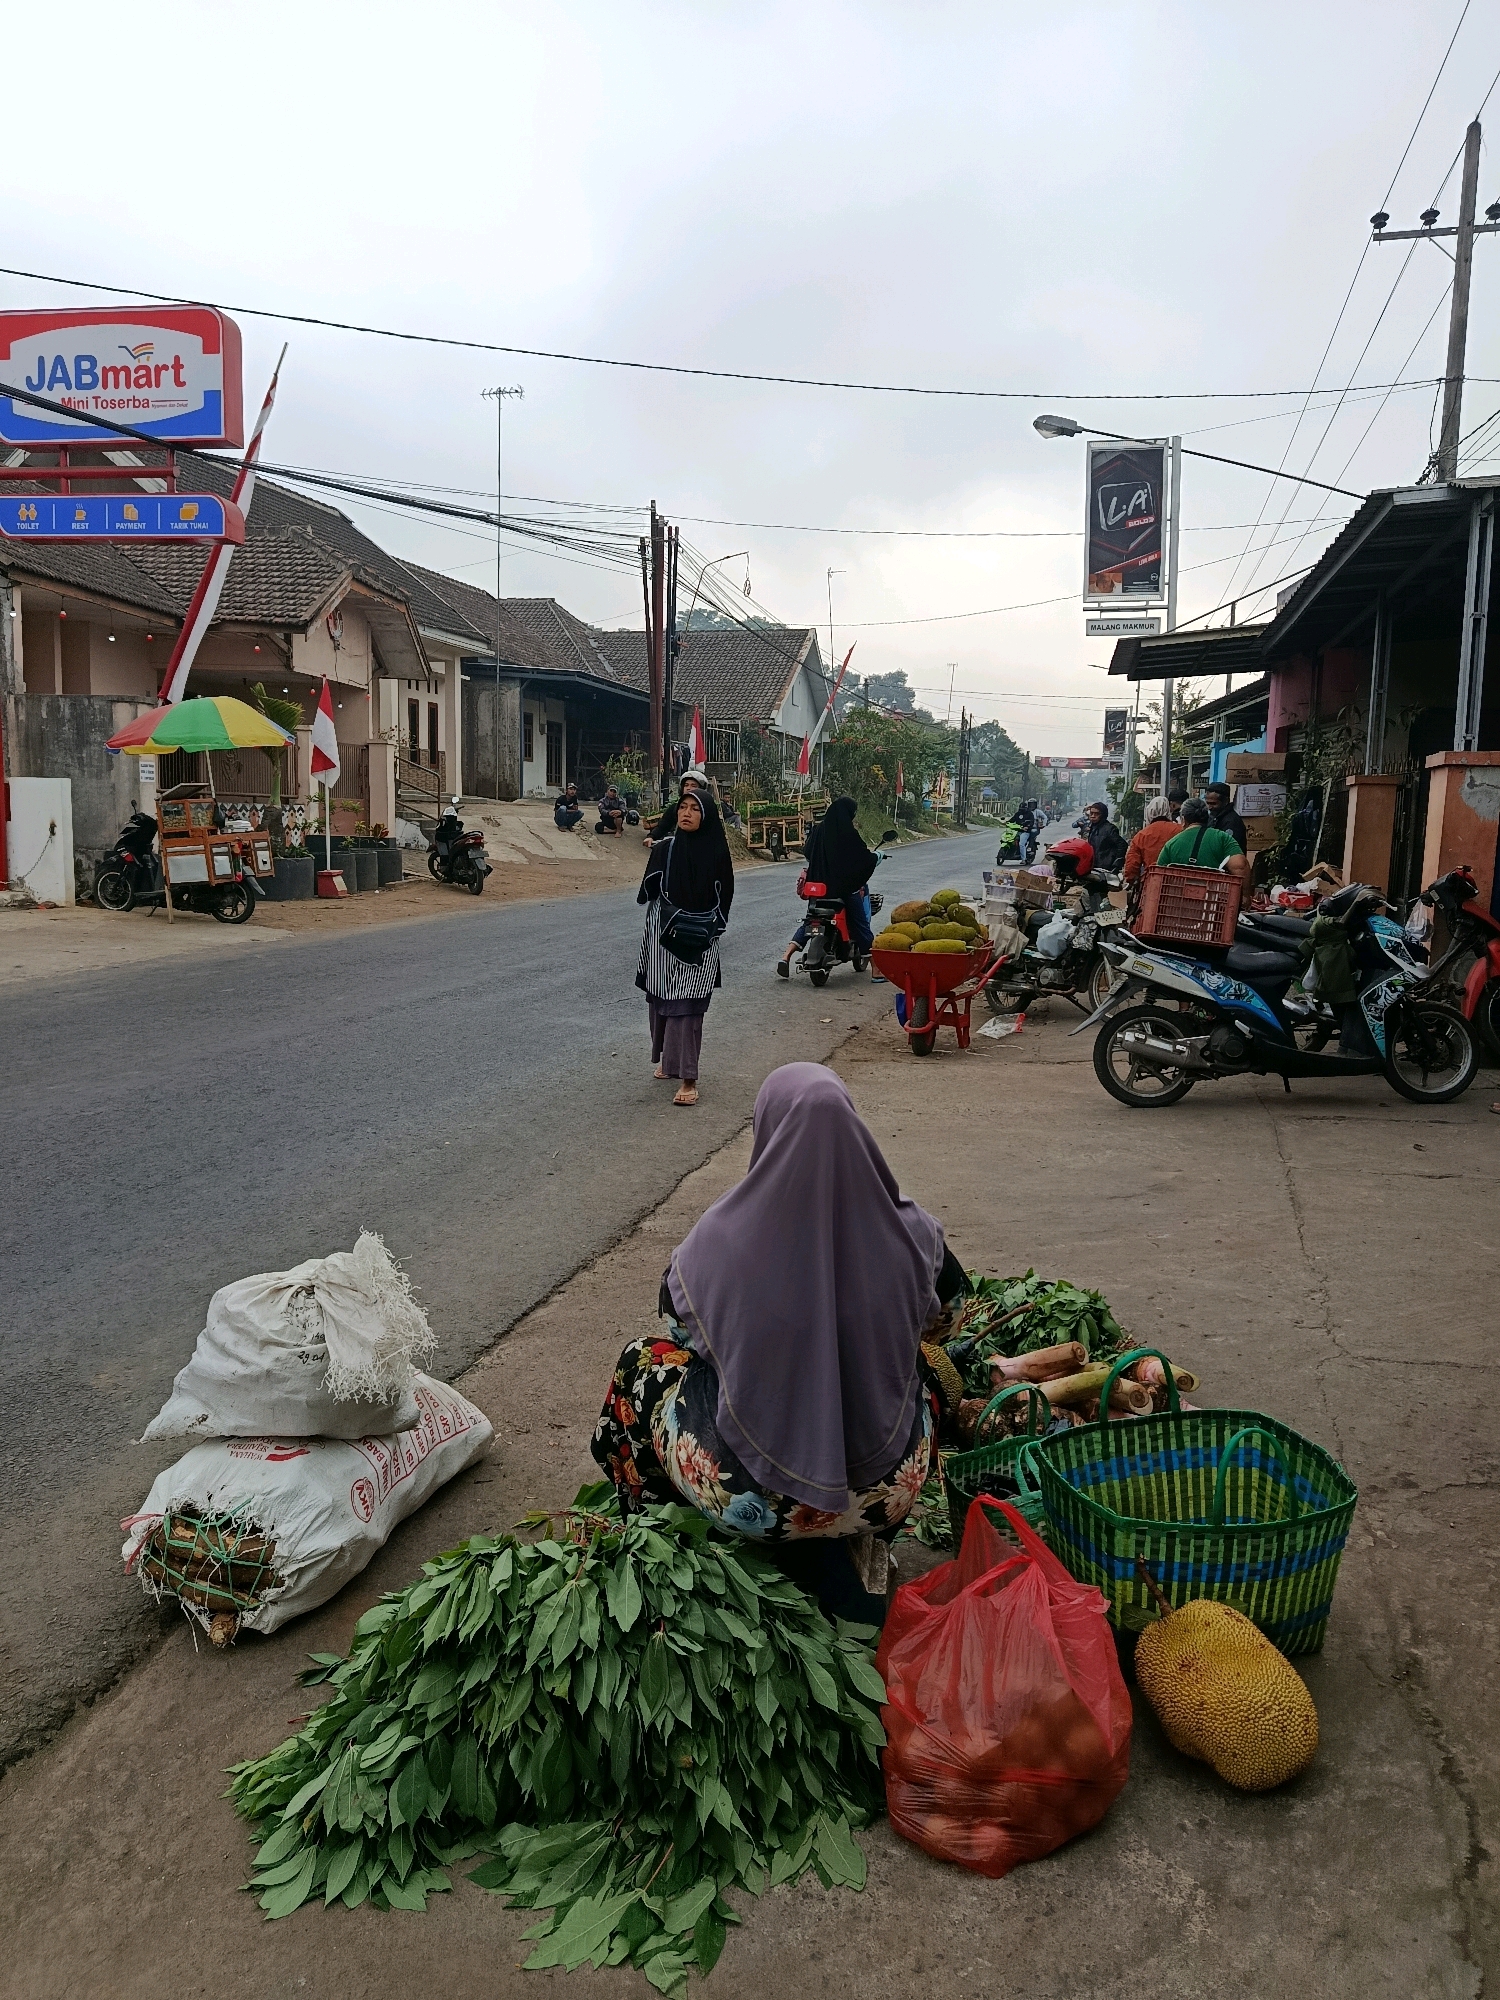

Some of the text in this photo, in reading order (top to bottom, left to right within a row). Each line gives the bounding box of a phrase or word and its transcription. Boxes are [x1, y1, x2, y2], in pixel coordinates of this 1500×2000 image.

[25, 354, 187, 392] JABmart
[61, 394, 150, 410] Mini Toserba
[16, 522, 40, 530] TOILET
[71, 522, 89, 530] REST
[115, 522, 147, 530] PAYMENT
[169, 522, 209, 530] TARIK TUNAI
[229, 1450, 263, 1461] WAHANA
[405, 1449, 415, 1468] ISI
[355, 1484, 371, 1518] NKV
